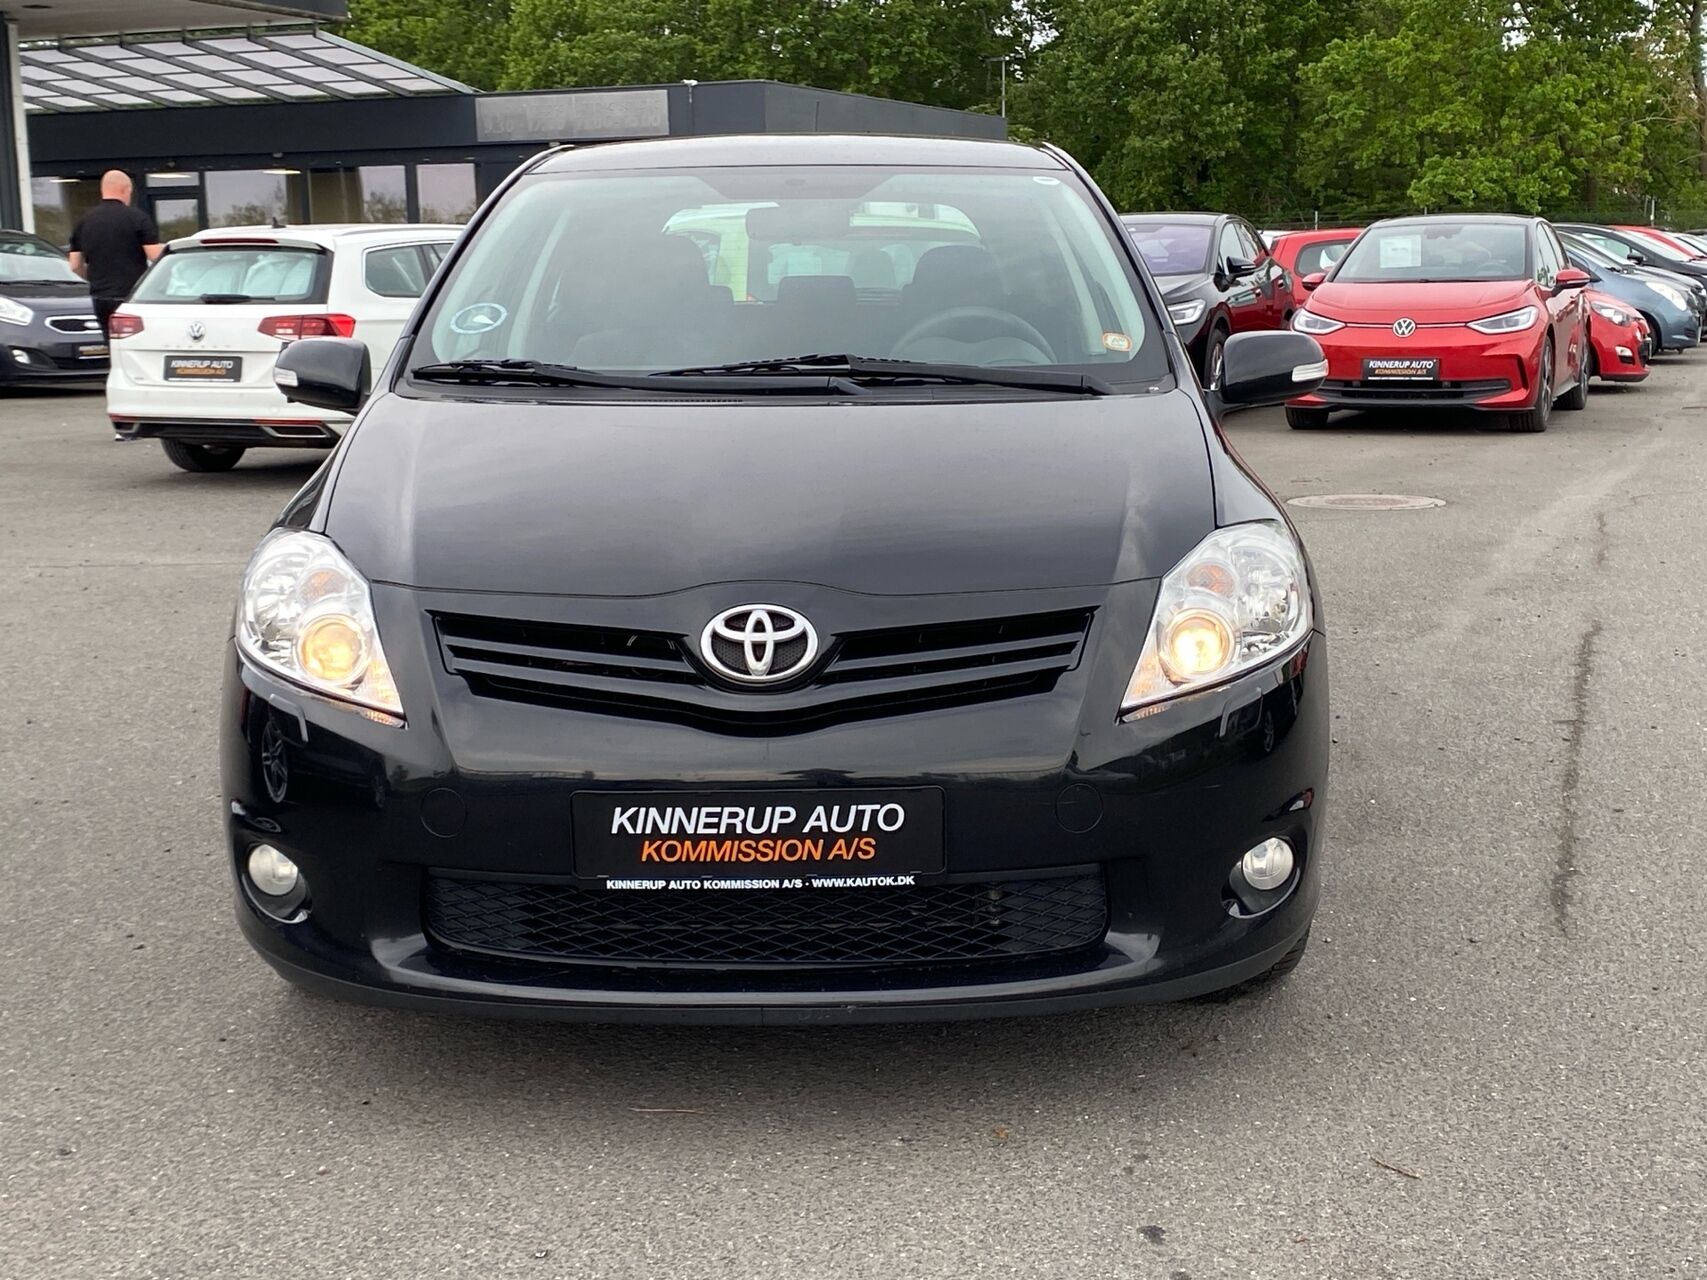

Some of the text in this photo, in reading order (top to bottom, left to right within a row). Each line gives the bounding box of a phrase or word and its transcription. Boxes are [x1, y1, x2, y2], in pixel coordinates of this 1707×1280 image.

[1369, 360, 1434, 369] KINNERUP AUTO
[611, 803, 905, 835] KINNERUP AUTO
[641, 837, 877, 862] KOMMISSION A/S
[606, 879, 667, 890] KINNERUP
[668, 879, 701, 890] AUTO
[703, 879, 780, 890] KOMMISSION
[782, 878, 803, 889] A/S
[812, 875, 916, 888] WWW.KAUTOK.DK
